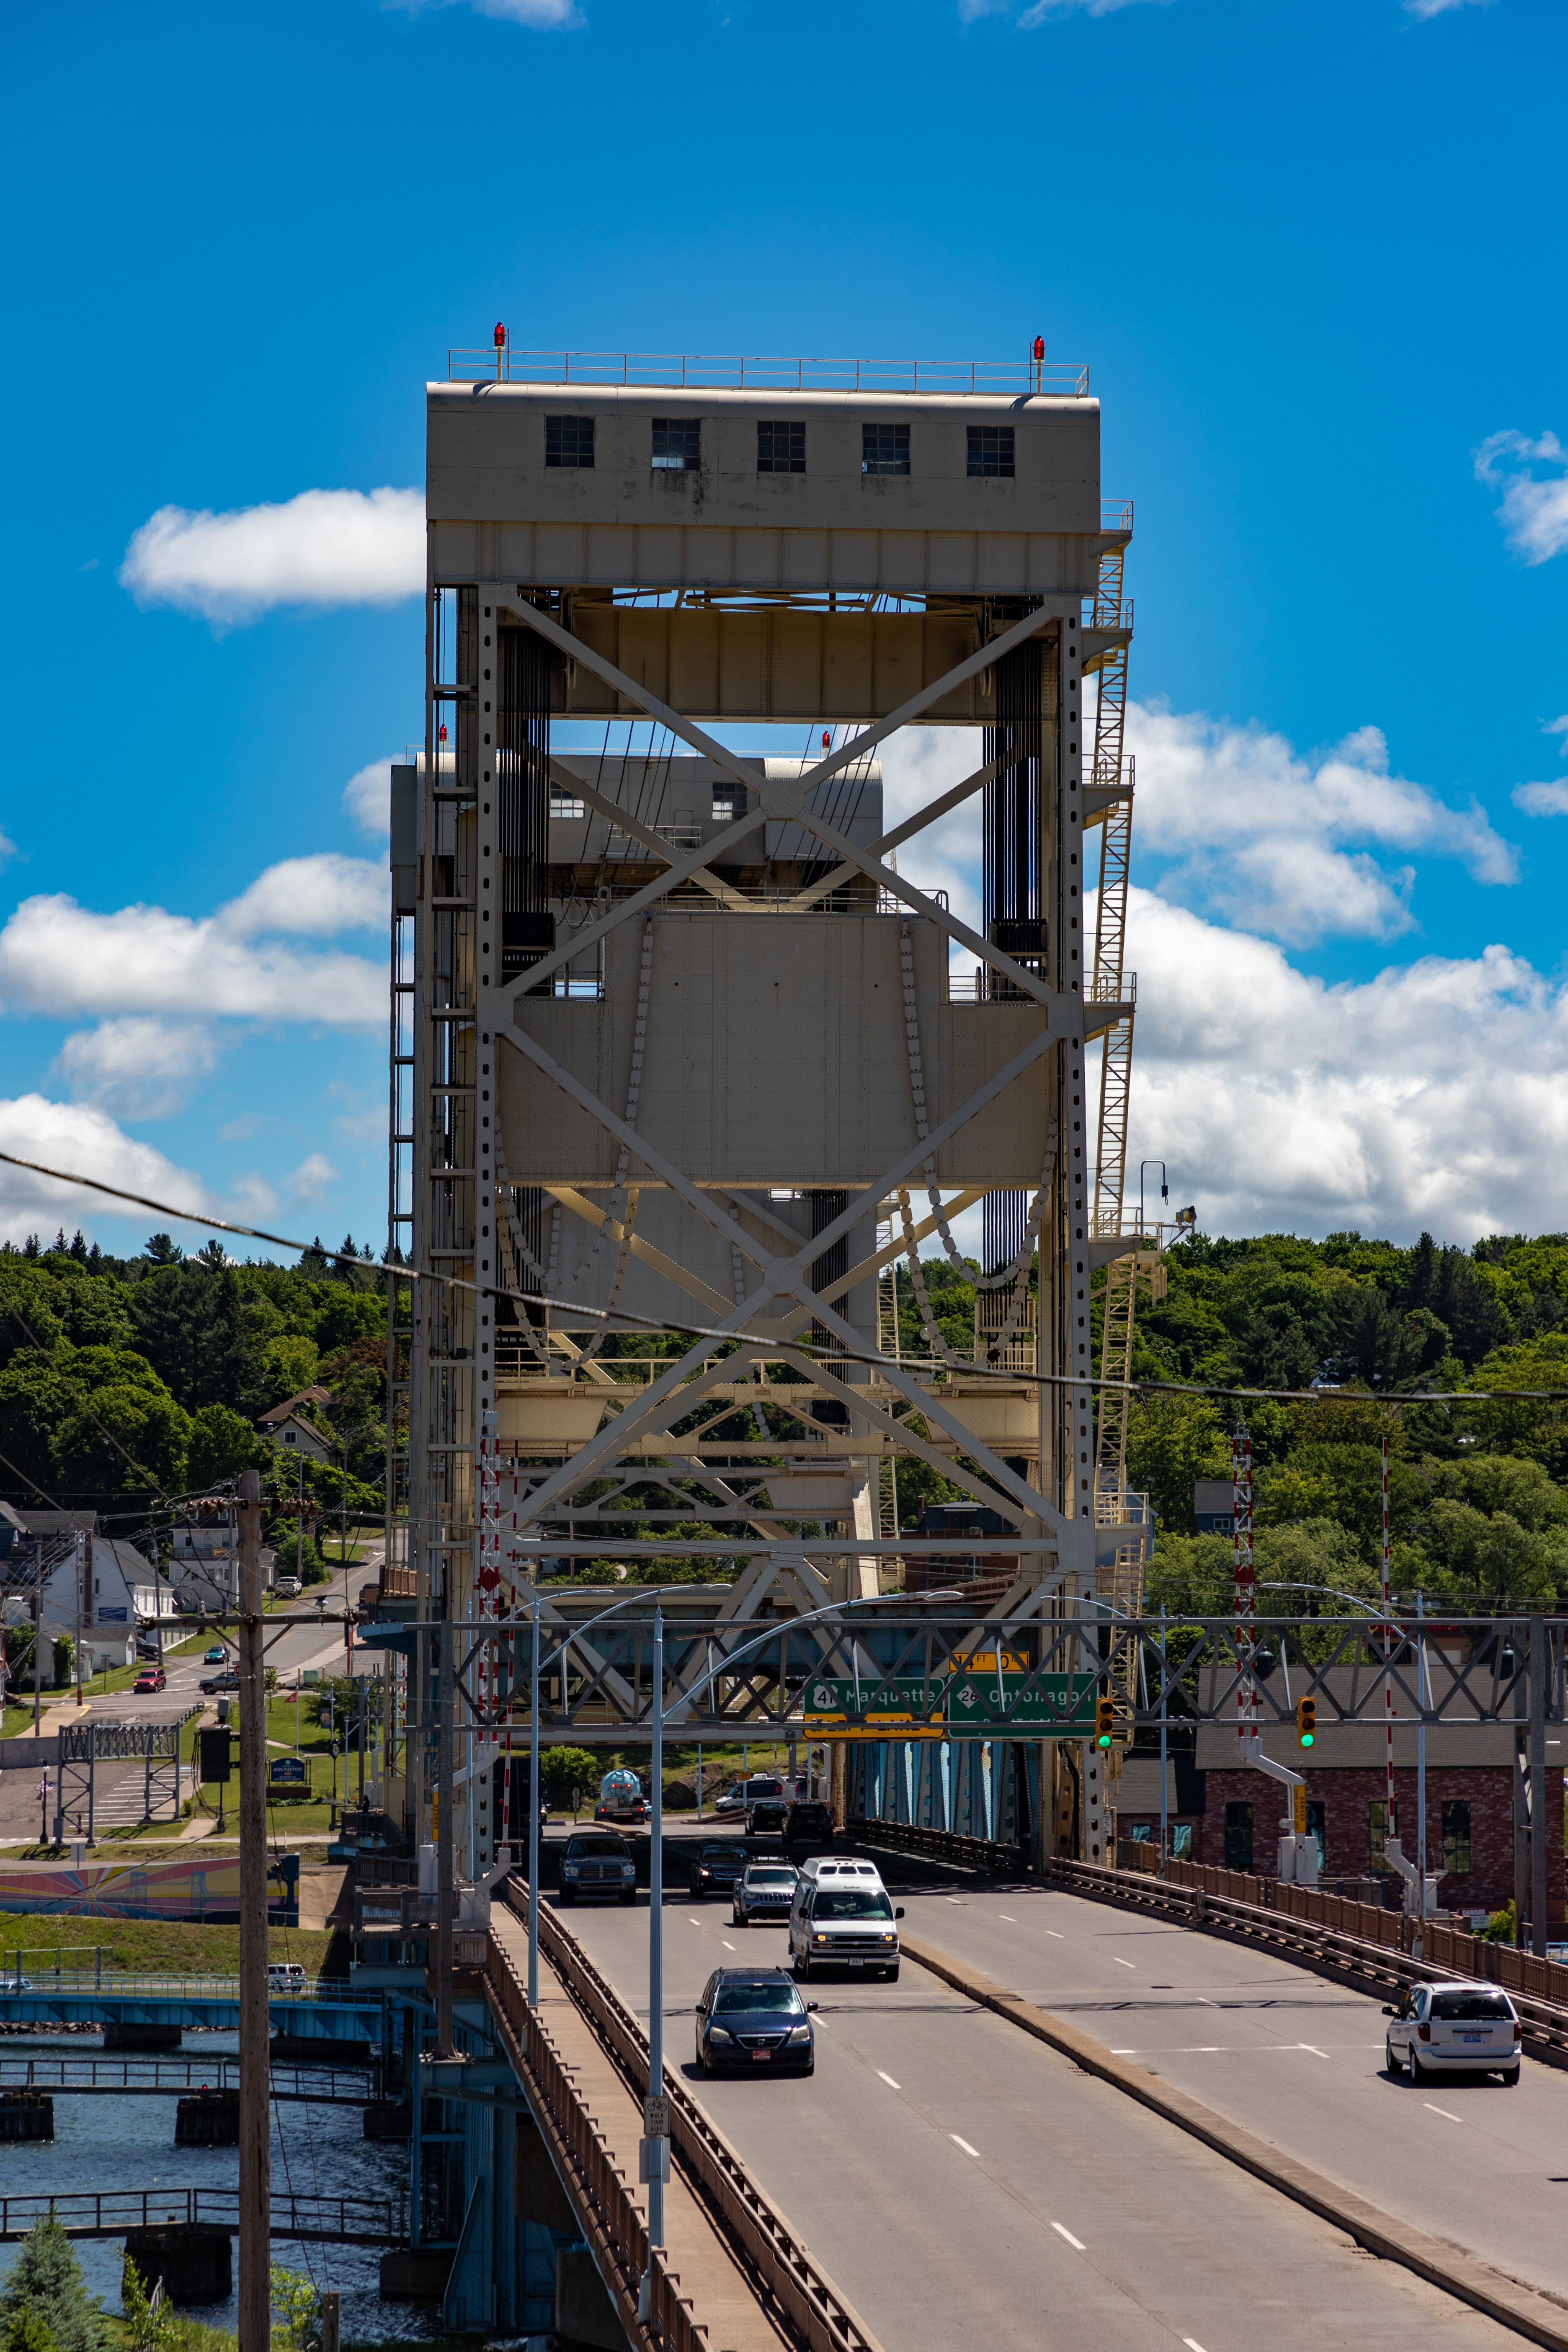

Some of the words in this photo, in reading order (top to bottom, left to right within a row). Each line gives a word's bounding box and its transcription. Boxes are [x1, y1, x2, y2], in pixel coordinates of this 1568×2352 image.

[1001, 1655, 1009, 1669] 0
[817, 1690, 833, 1704] 41
[846, 1689, 935, 1705] Marquette
[961, 1690, 977, 1702] 26
